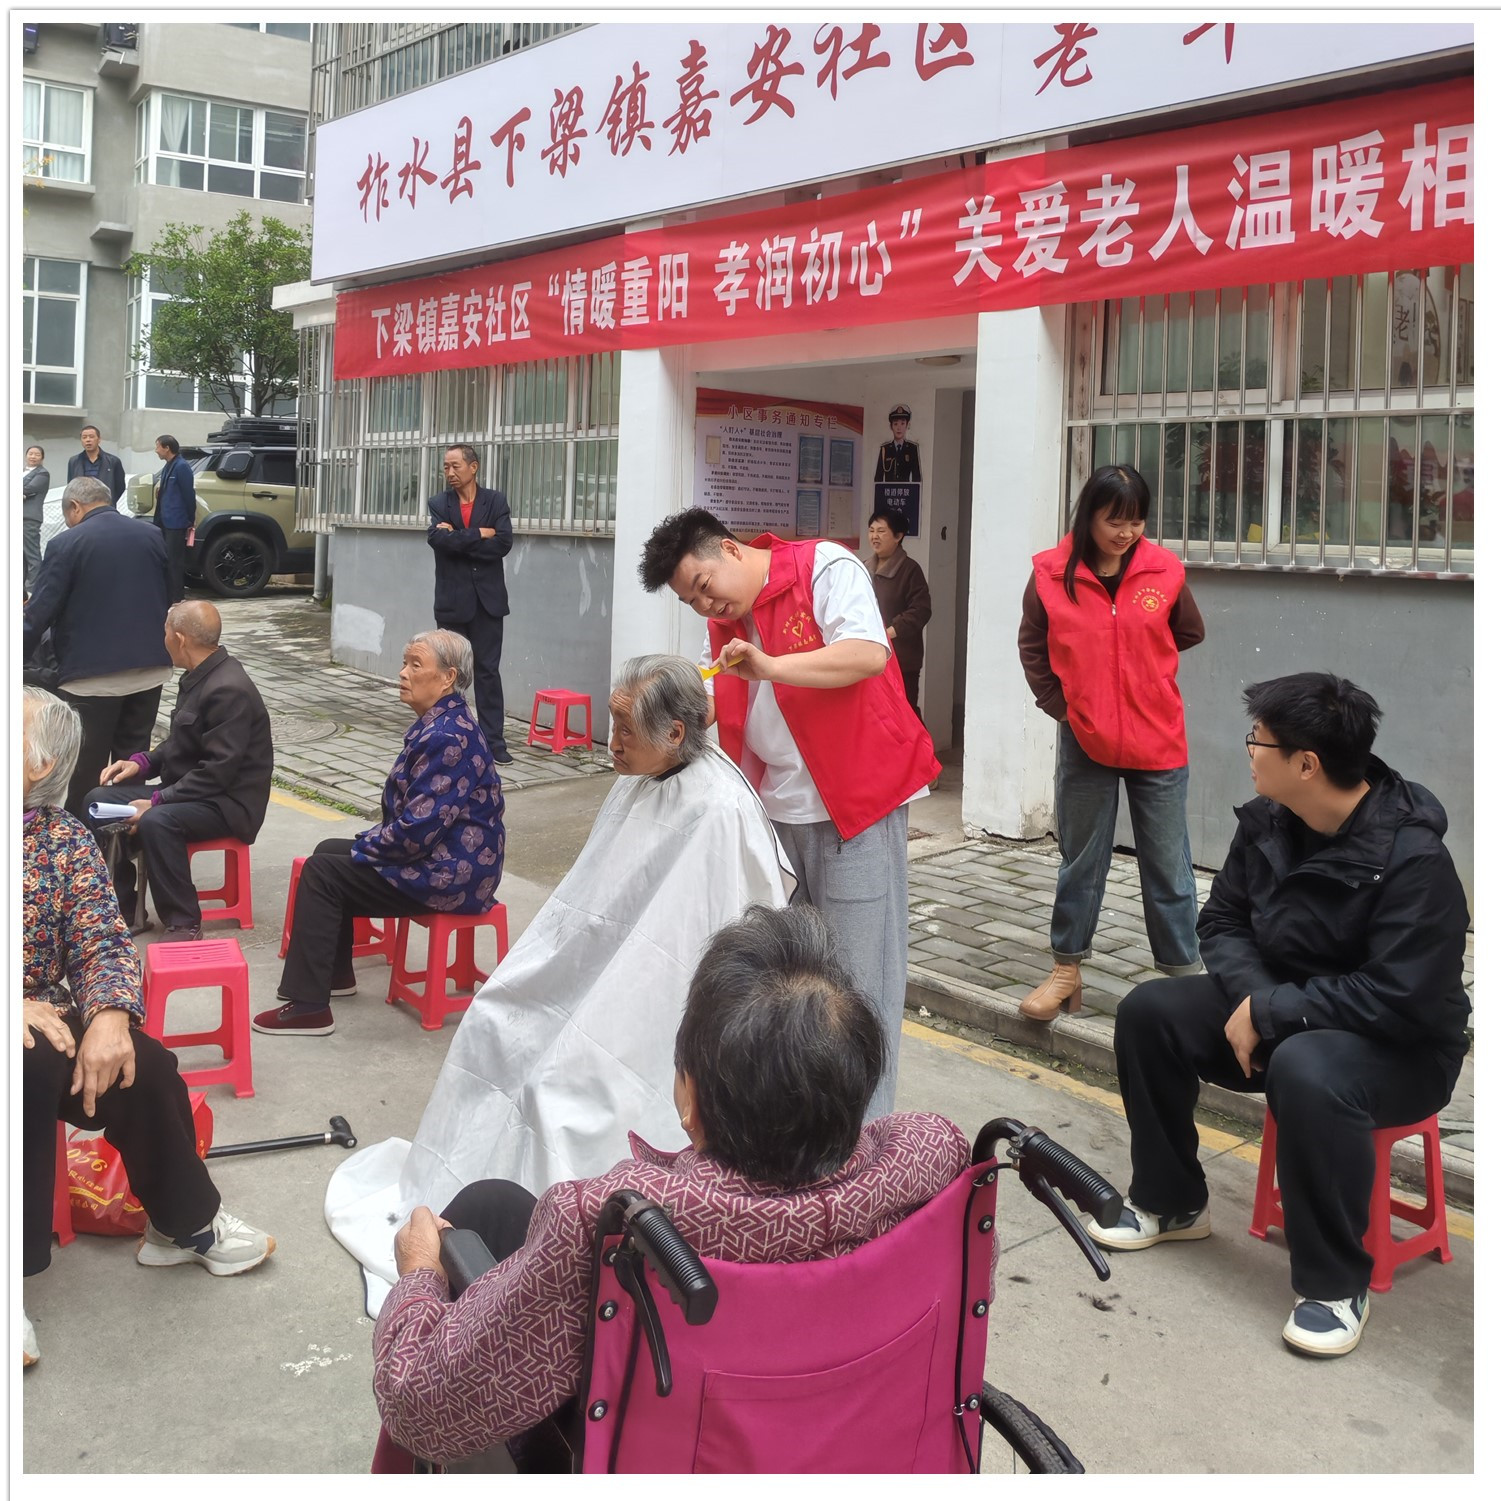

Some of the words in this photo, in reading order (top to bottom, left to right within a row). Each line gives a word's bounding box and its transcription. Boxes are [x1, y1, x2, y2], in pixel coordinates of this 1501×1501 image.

[371, 280, 533, 359] 下梁镇嘉安社区
[953, 122, 1474, 287] 关爱老人温暖相
[728, 404, 838, 430] 小区事务通知专栏
